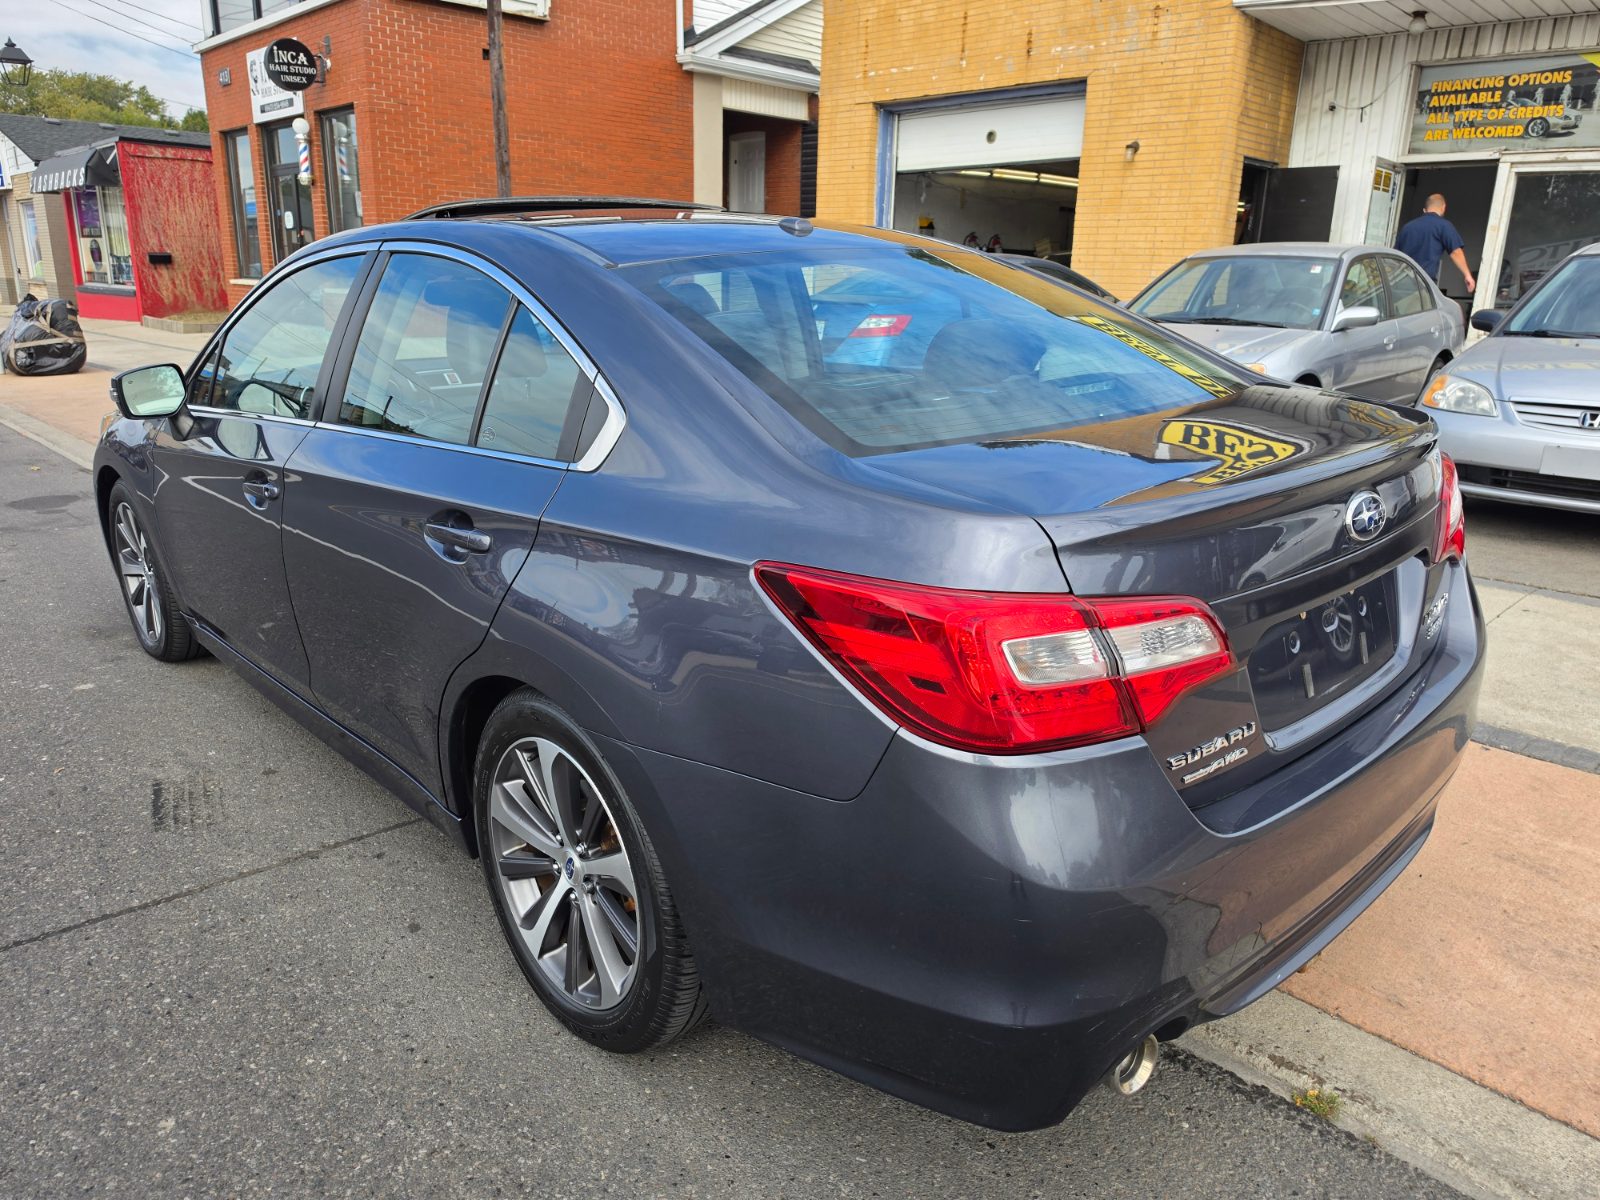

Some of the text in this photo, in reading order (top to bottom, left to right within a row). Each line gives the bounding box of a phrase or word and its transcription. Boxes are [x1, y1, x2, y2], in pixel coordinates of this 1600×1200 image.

[269, 63, 289, 73] HAIR
[289, 64, 317, 75] STUDIO
[280, 74, 307, 83] UNISEX
[1431, 70, 1573, 93] FINANCING OPTIONS
[1429, 91, 1502, 107] AVAILABLE
[1425, 105, 1565, 125] ALL TYPE OF CREDITS
[1424, 125, 1525, 141] ARE WELCOMED
[1167, 721, 1256, 771] SUBARU
